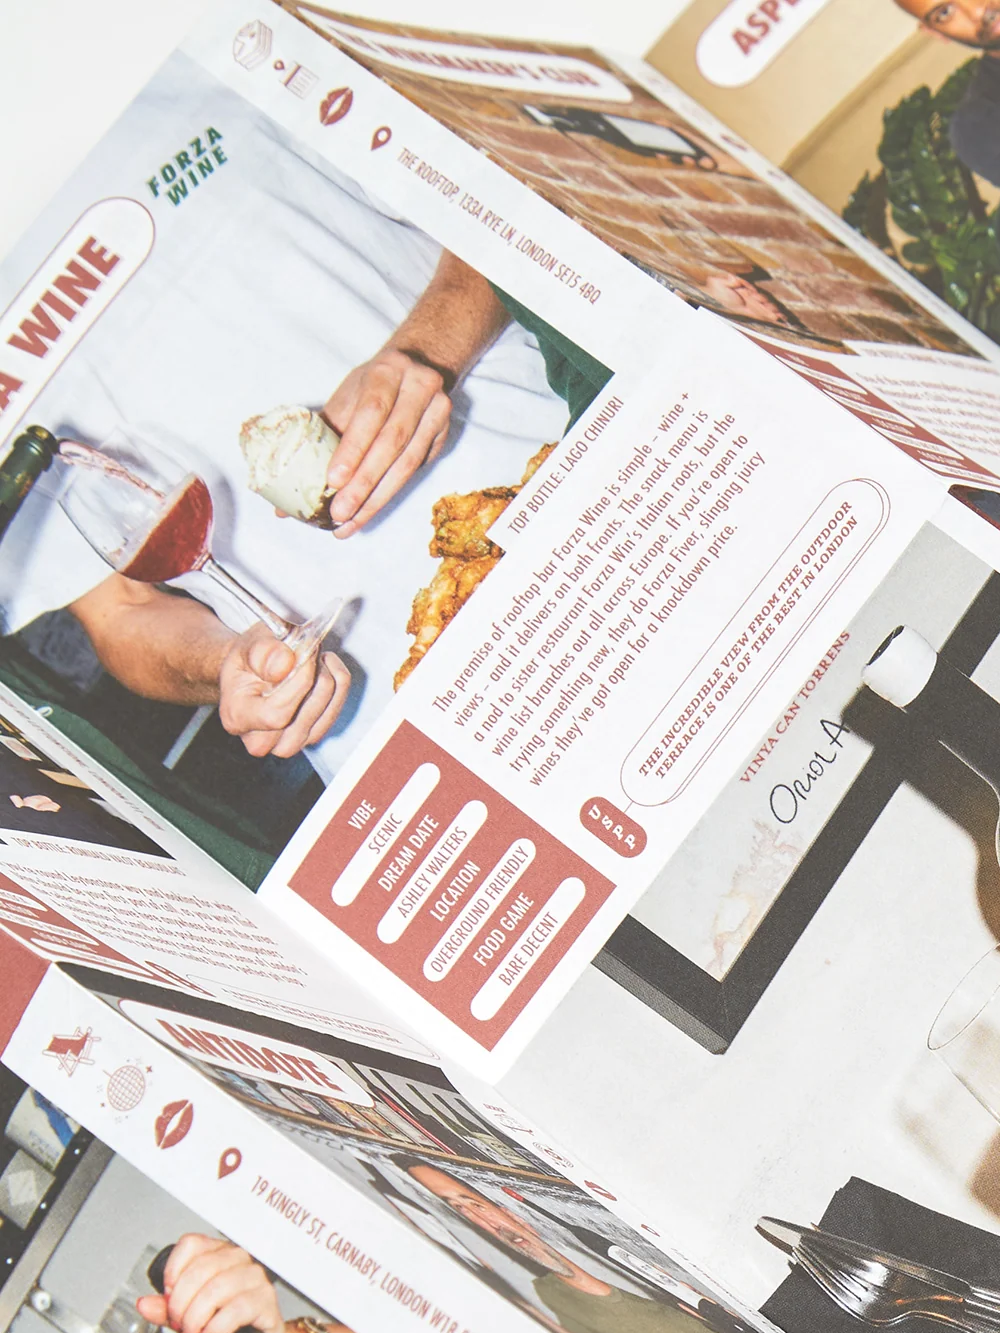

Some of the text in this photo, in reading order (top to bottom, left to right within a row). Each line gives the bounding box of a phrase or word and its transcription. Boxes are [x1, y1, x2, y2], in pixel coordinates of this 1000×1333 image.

[732, 0, 799, 55] ASP
[146, 126, 223, 198] FORZA
[166, 145, 228, 207] WINE
[397, 147, 601, 305] THE ROOFTOP, 133A RYE LN, LONDON SE15 4BQ
[6, 235, 121, 358] WINE
[506, 509, 530, 534] TOP
[558, 440, 588, 472] LAGO
[583, 395, 624, 442] CHINURI
[431, 689, 457, 712] The
[453, 641, 494, 692] premise
[491, 621, 505, 641] of
[502, 582, 541, 627] rooftop
[532, 559, 558, 583] bar
[551, 526, 586, 561] Forza
[578, 495, 611, 526] Wine
[604, 483, 621, 496] is
[617, 444, 652, 484] simple
[657, 403, 684, 432] wine
[508, 450, 765, 772] trying something new, they do Forza Fiver, slinging juicy
[638, 500, 852, 776] THE INCREDIBLE VIEW FROM THE OUTDOOR
[654, 515, 858, 779] TERRACE IS ONE OF THE BEST IN LONDON
[739, 630, 850, 782] VINYA CAN TORRENS
[347, 798, 376, 830] VIBE
[367, 812, 402, 854] SCENIC
[377, 813, 439, 892] DREAM DATE
[397, 825, 467, 918] ASHLEY WALTERS
[429, 859, 481, 922] LOCATION
[430, 845, 529, 973] OVERGROUND FRIENDLY
[472, 891, 534, 967] FOOD GAME
[497, 910, 558, 986] BARE DECENT
[154, 1019, 346, 1093] ANTIDOTE
[250, 1174, 270, 1196] 19
[264, 1186, 318, 1233] KINGLY
[305, 1217, 337, 1247] ST,
[325, 1231, 391, 1289] CARNABY,
[380, 1276, 438, 1320] LONDON
